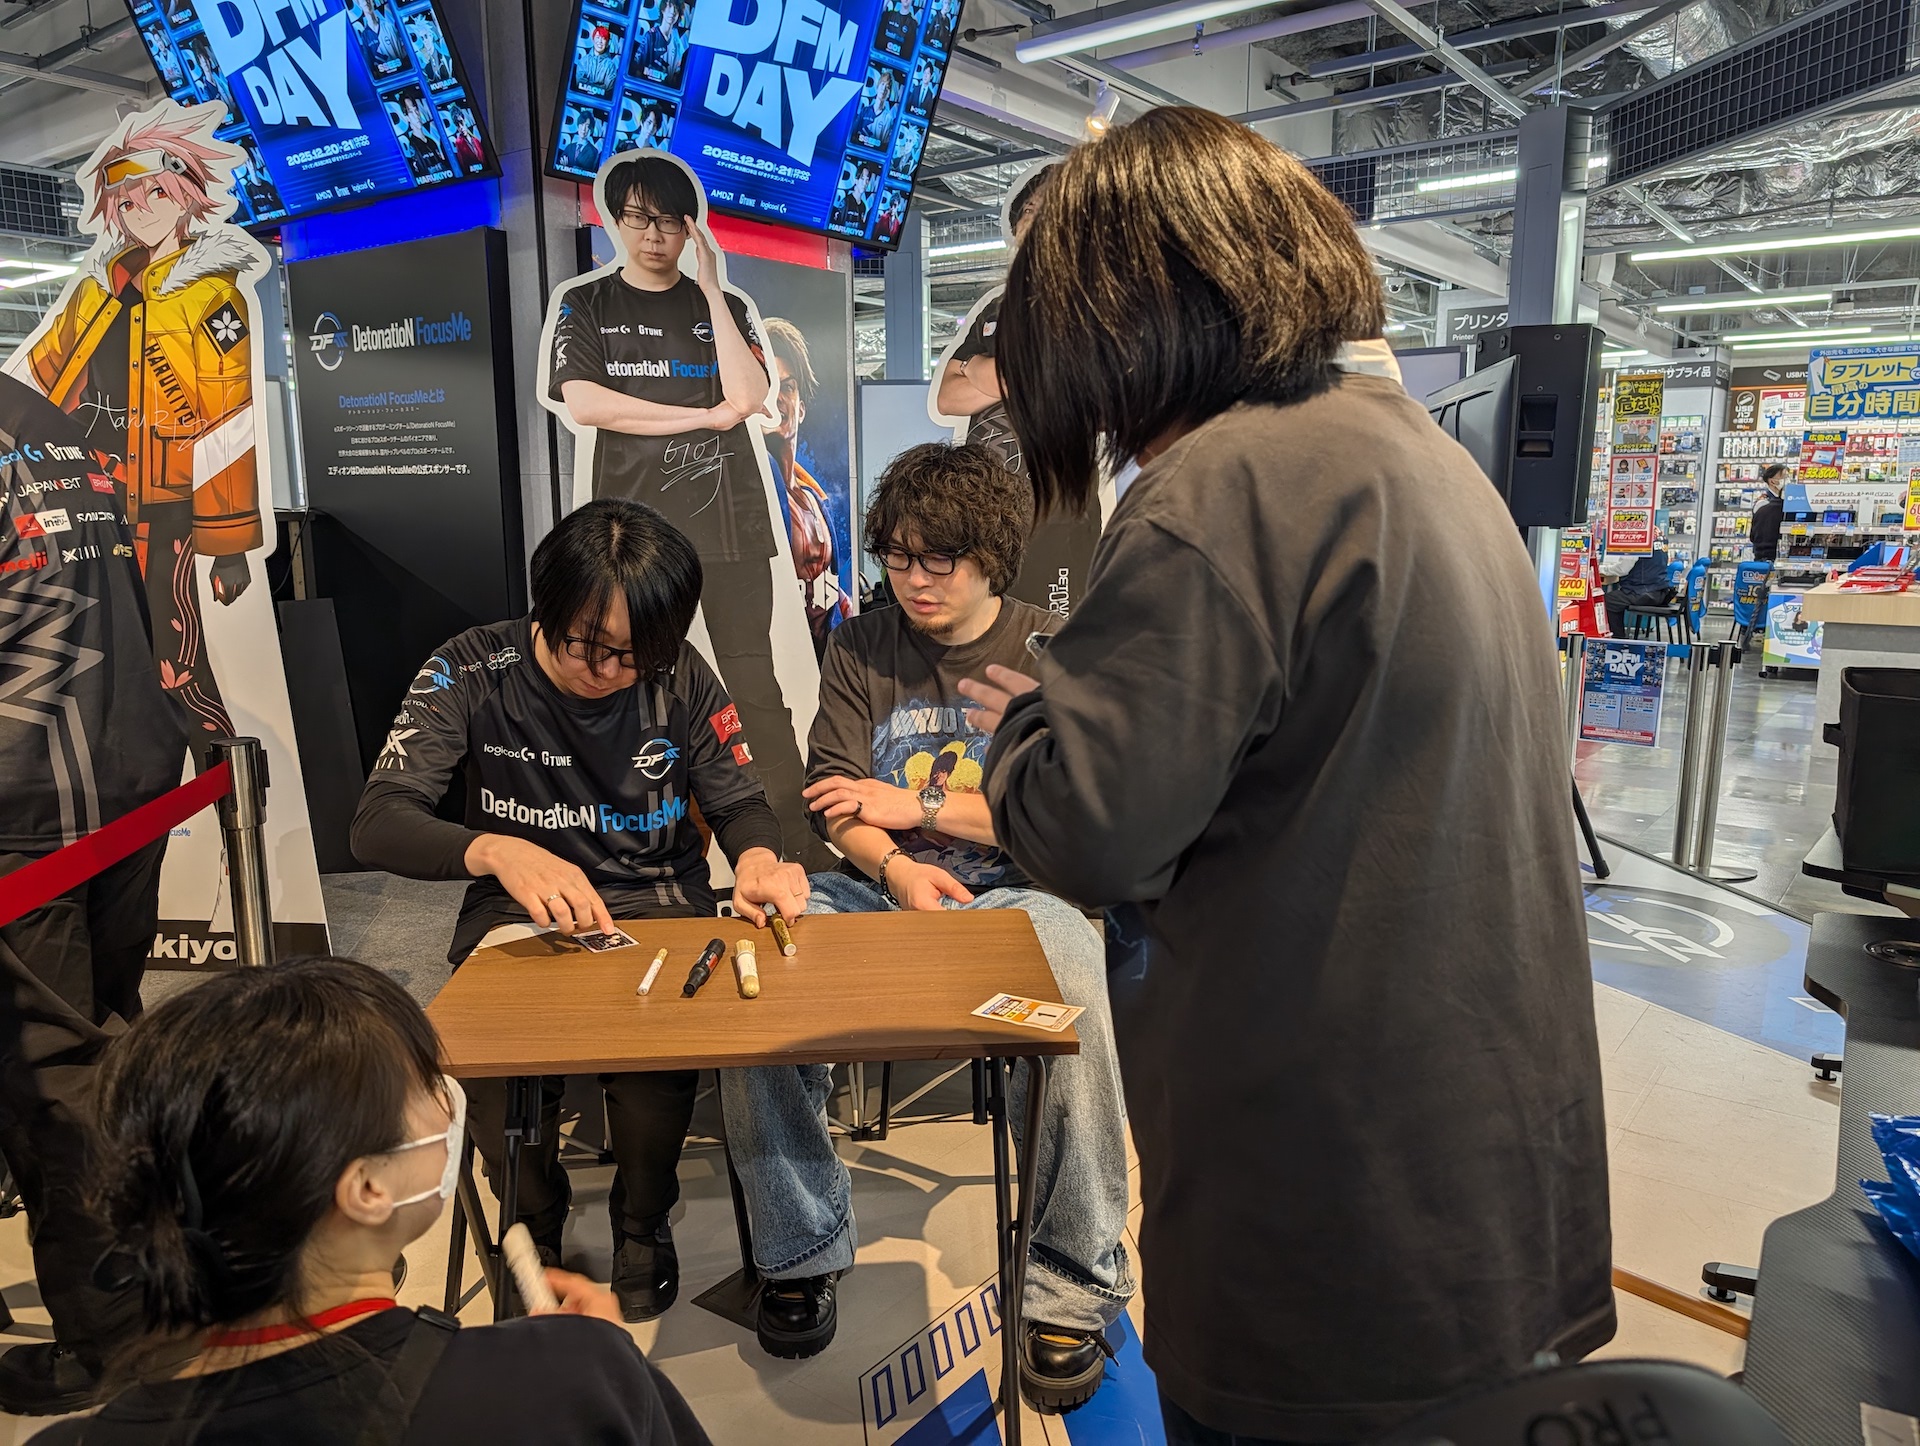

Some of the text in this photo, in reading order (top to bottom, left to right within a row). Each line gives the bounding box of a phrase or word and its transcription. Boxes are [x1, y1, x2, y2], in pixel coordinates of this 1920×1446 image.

[688, 0, 859, 75] DFM
[241, 9, 362, 130] DAY
[703, 52, 864, 168] DAY
[352, 311, 472, 352] DetonatioN FocusMe
[638, 325, 664, 337] GTUNE
[1453, 312, 1508, 331] プリンタ
[605, 360, 670, 378] etonatioN
[1831, 362, 1911, 379] タブレット
[145, 341, 196, 427] HARUKIYO
[339, 393, 388, 409] DetonatioN
[1810, 391, 1920, 417] 自分時間
[44, 442, 86, 461] GTUNE
[1605, 649, 1641, 664] DFM
[1609, 662, 1645, 678] DAY
[483, 743, 521, 758] logicoo
[541, 750, 573, 768] GTUNE
[480, 786, 689, 834] DetonatioN FocusMe
[147, 932, 238, 965] kiyo
